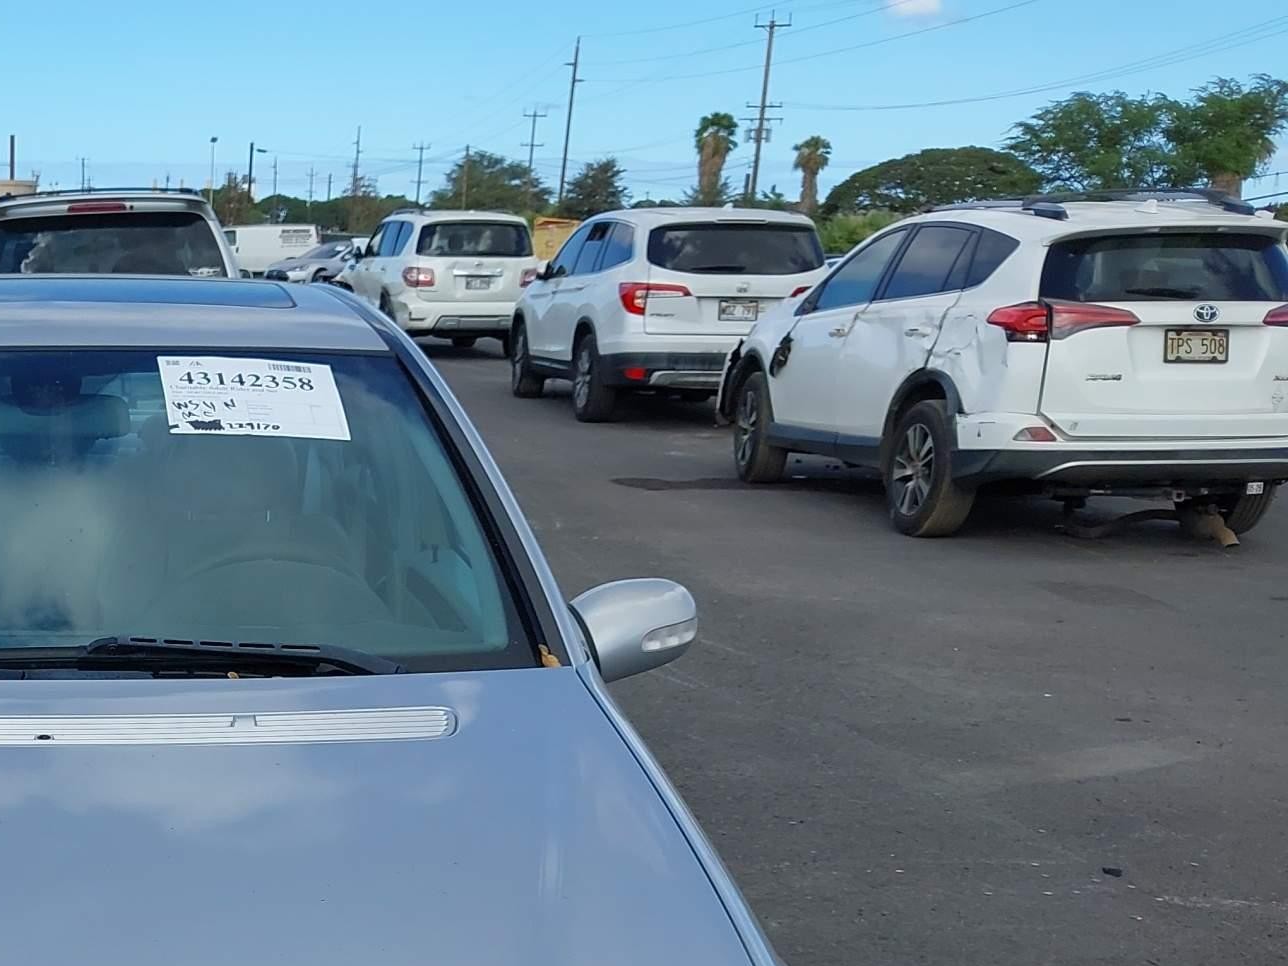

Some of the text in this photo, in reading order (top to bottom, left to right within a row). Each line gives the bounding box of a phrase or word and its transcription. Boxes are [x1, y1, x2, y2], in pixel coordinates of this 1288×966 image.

[1168, 337, 1225, 355] TPS 508
[179, 371, 314, 391] 43142358
